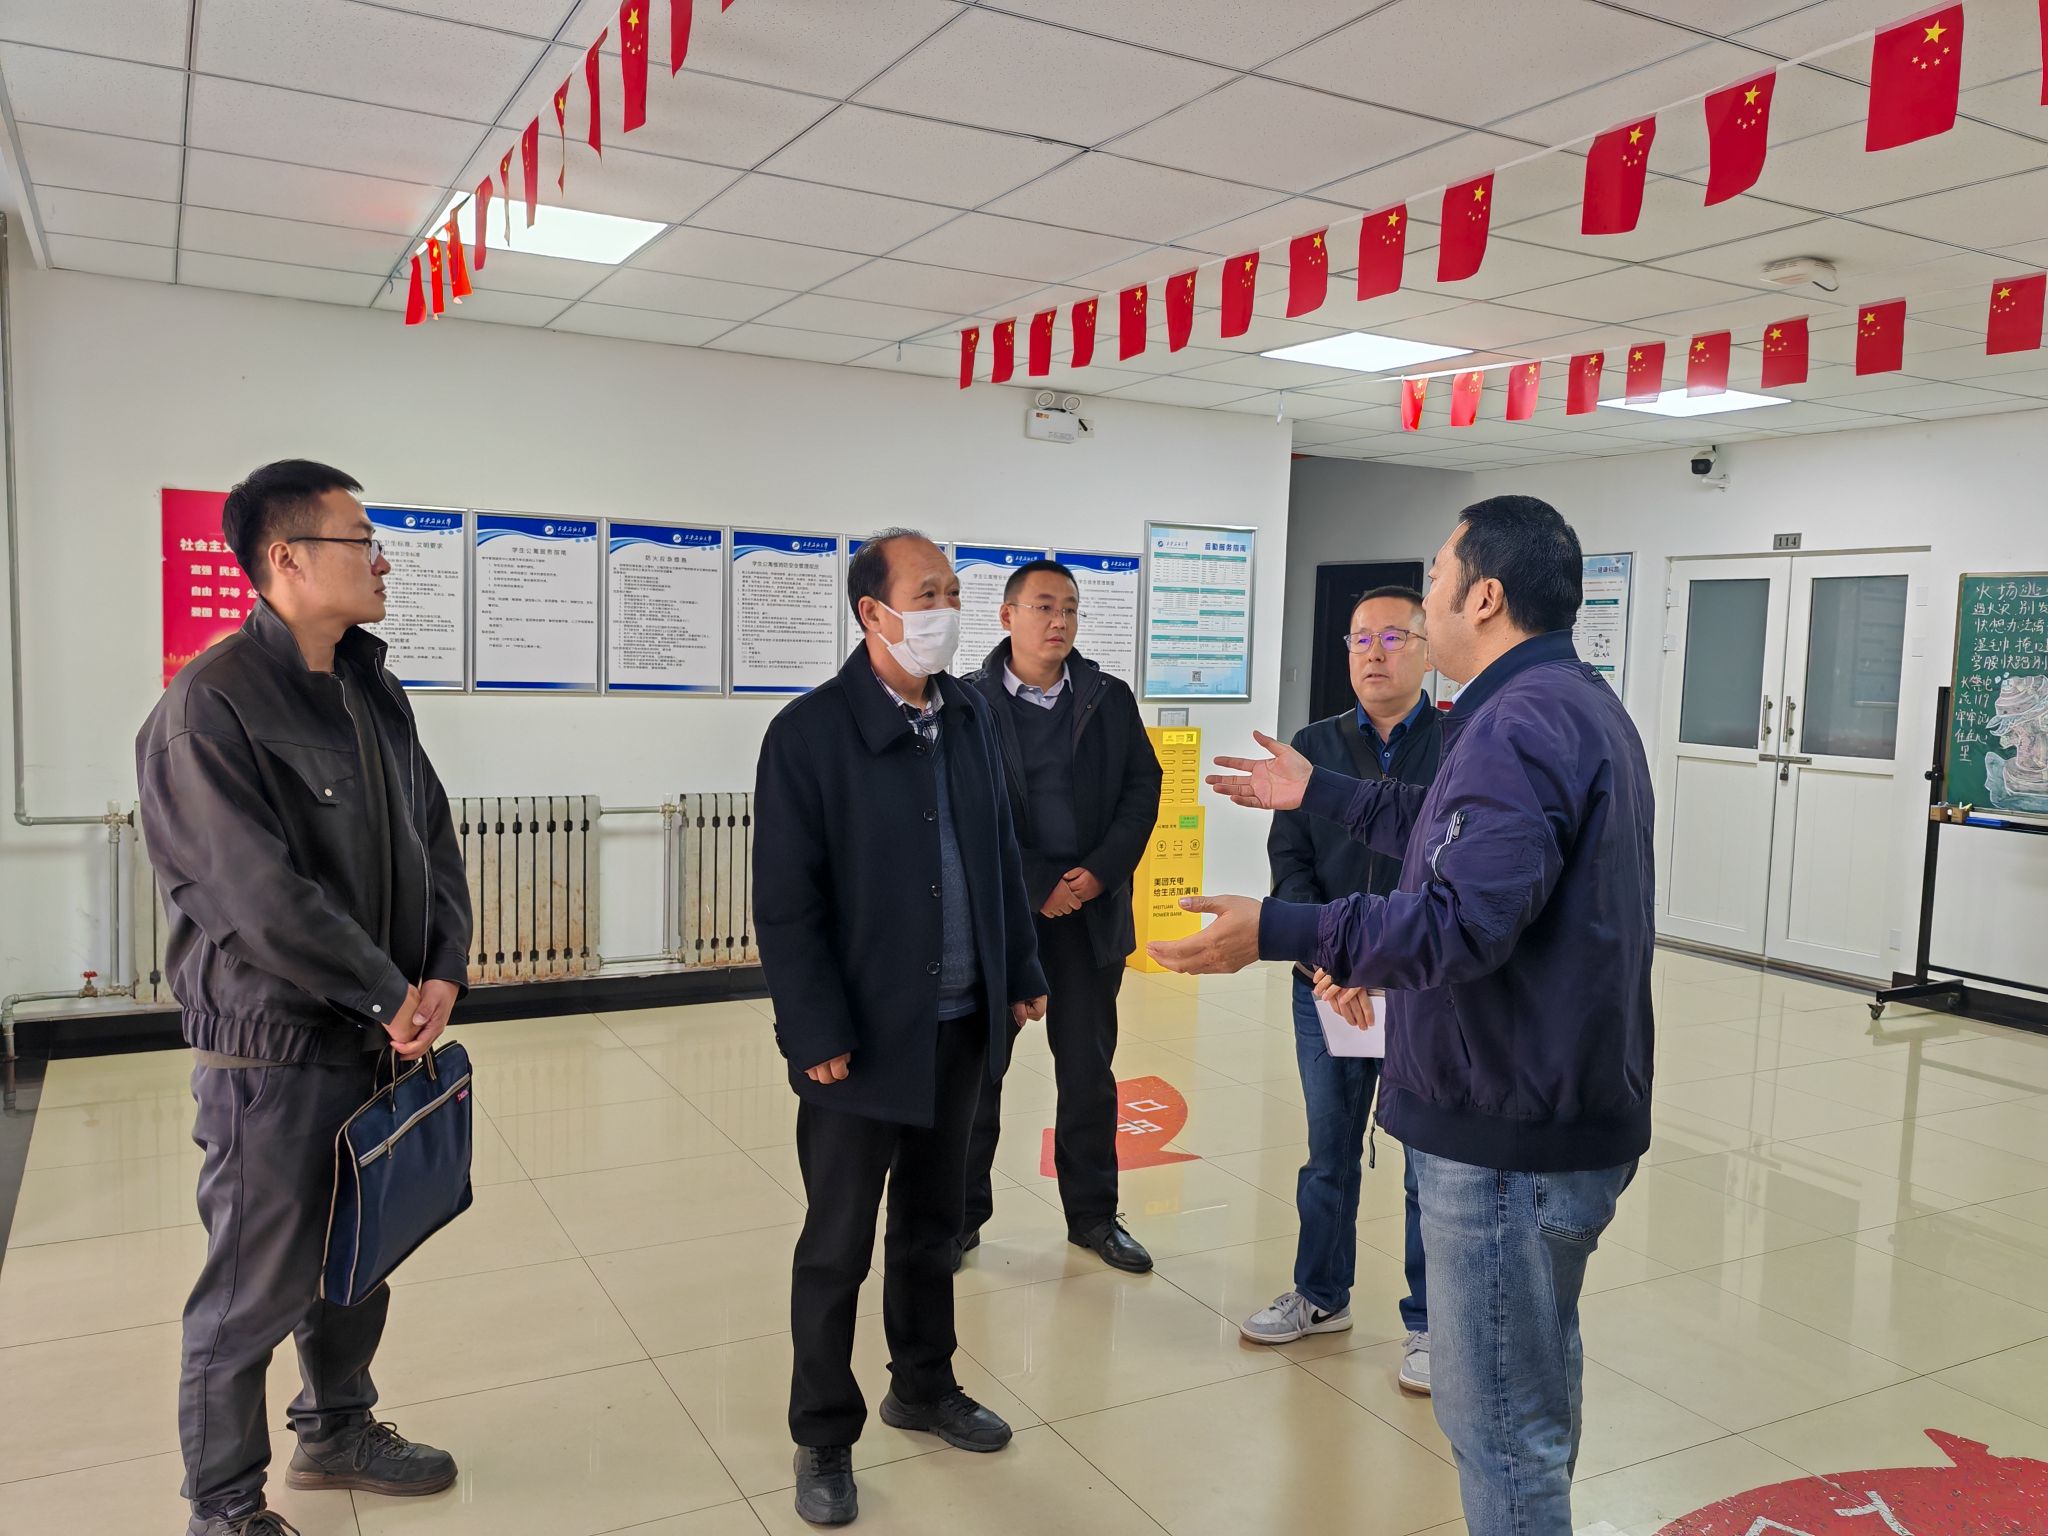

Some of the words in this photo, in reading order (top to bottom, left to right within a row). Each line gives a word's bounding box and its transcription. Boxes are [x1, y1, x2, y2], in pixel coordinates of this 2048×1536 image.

[1778, 536, 1797, 547] 114
[190, 564, 213, 576] 富强
[219, 565, 241, 577] 民主
[191, 586, 213, 597] 自由
[219, 587, 241, 598] 平等
[218, 607, 241, 619] 敬业
[1153, 877, 1184, 886] 美团充电
[1153, 887, 1199, 897] 给生活加满电
